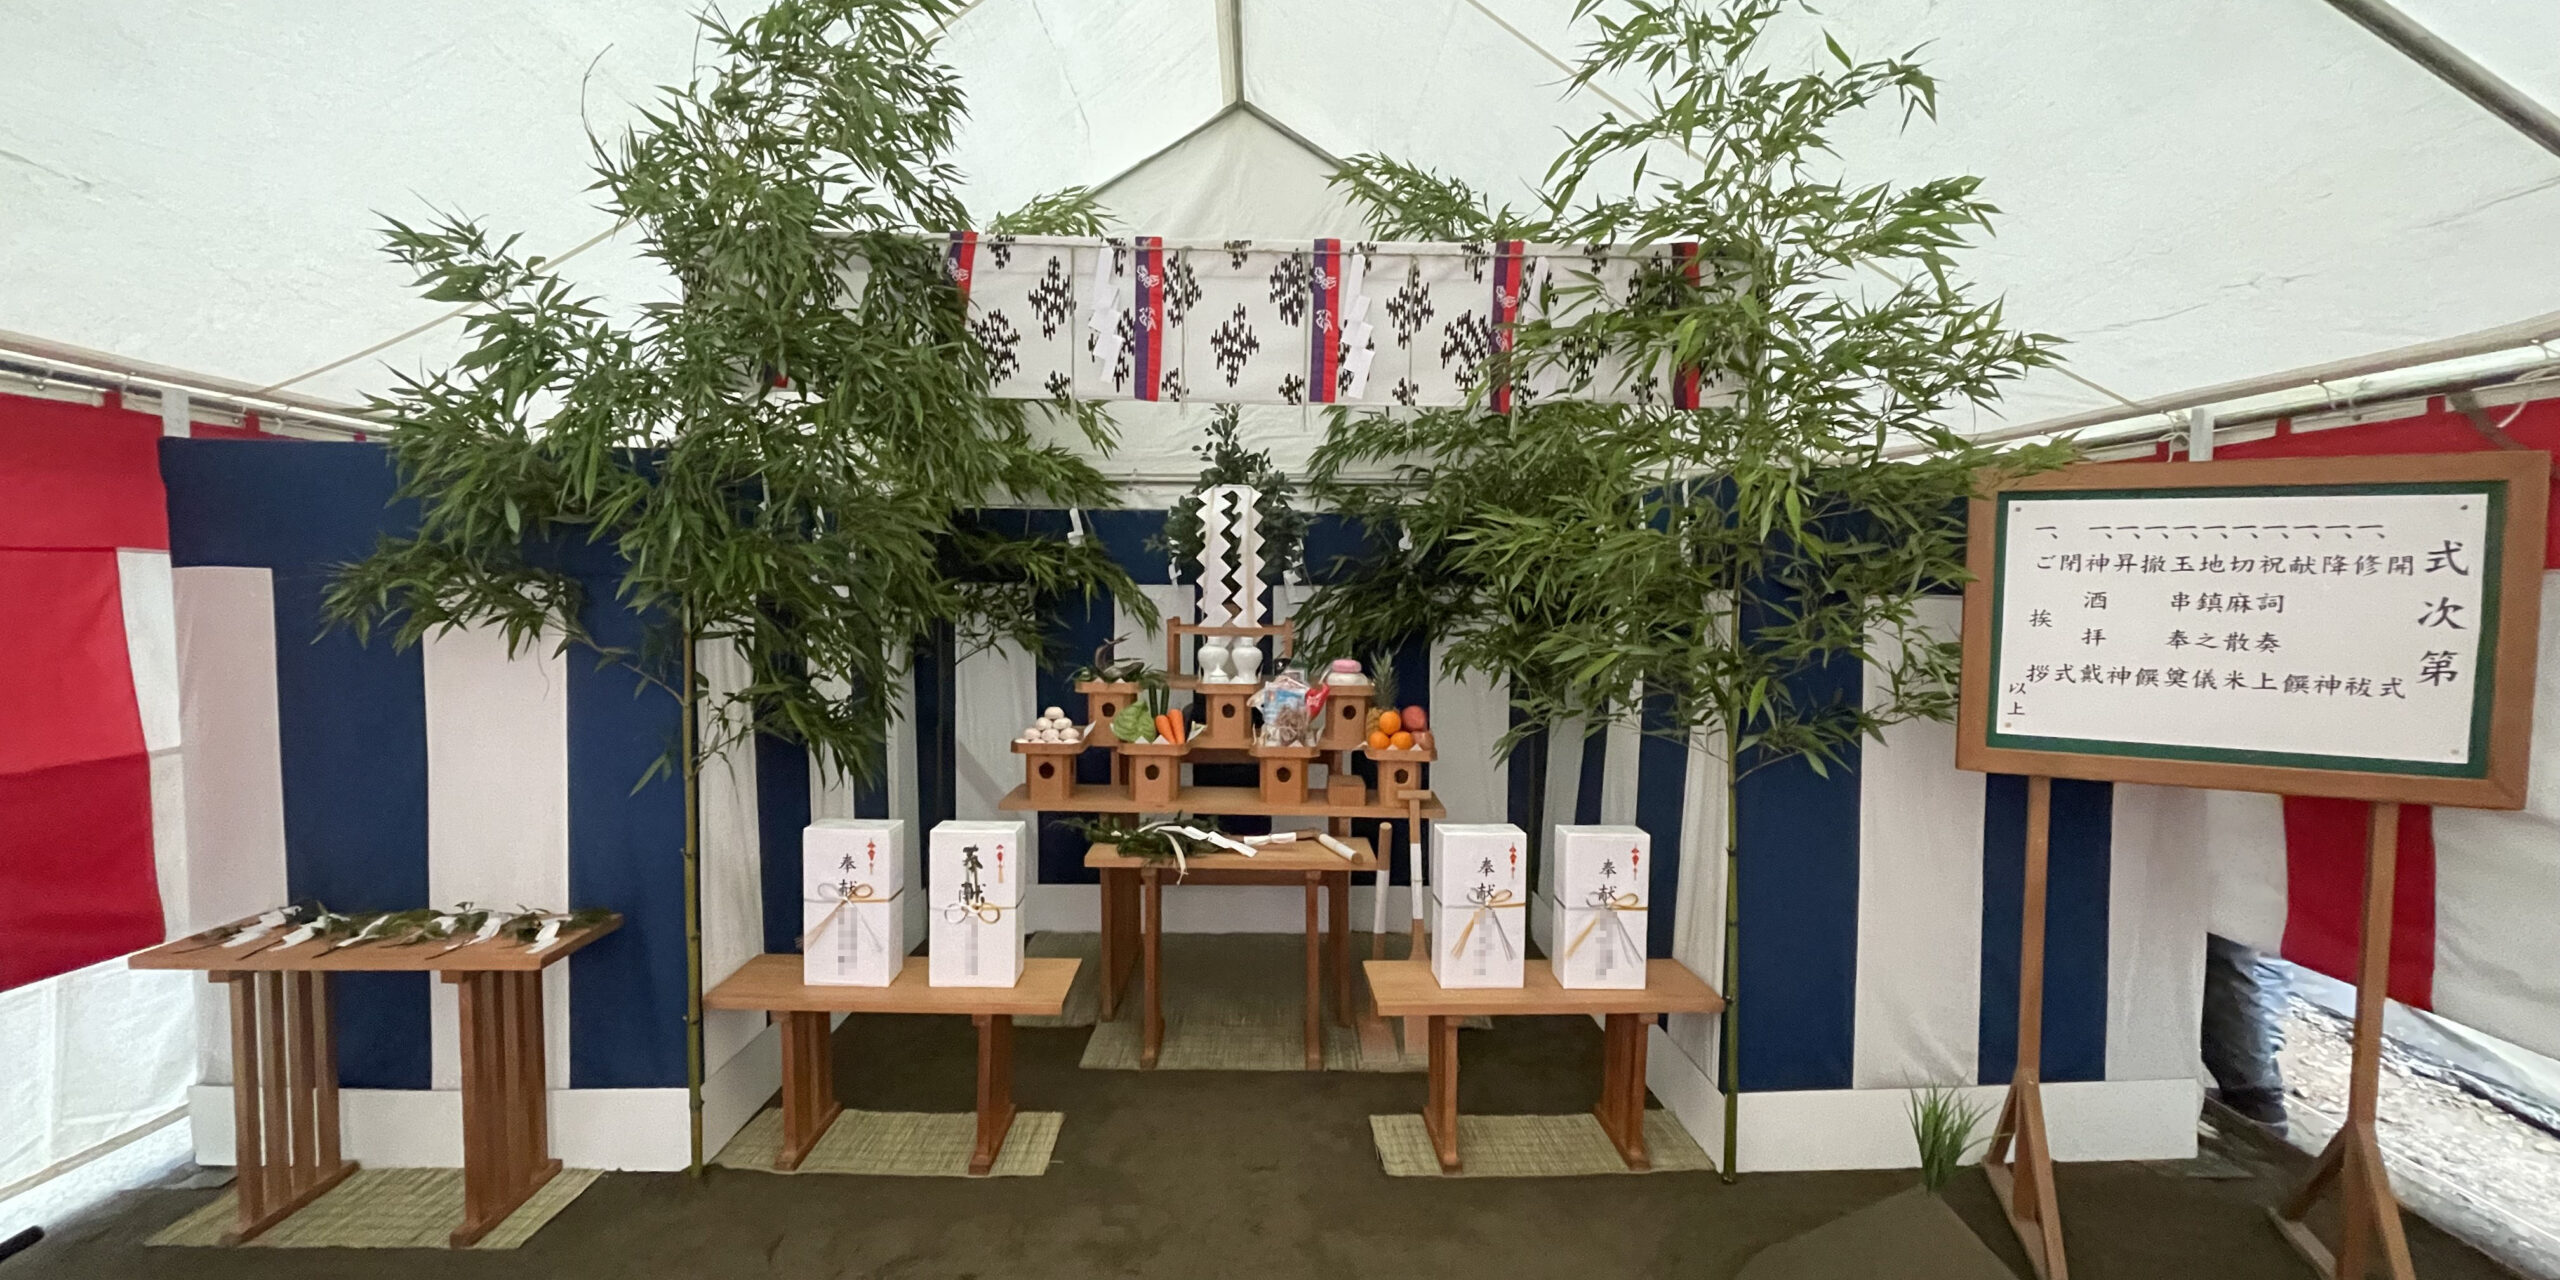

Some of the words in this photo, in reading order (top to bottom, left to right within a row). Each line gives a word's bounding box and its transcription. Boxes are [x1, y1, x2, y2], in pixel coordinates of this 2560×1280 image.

[2054, 554, 2081, 684] 閉式
[2379, 556, 2415, 699] 開式
[2416, 539, 2469, 687] 式次第
[2007, 682, 2027, 716] 以上
[838, 853, 857, 898] 奉献
[1477, 857, 1496, 904] 奉献
[1598, 858, 1617, 906] 奉献
